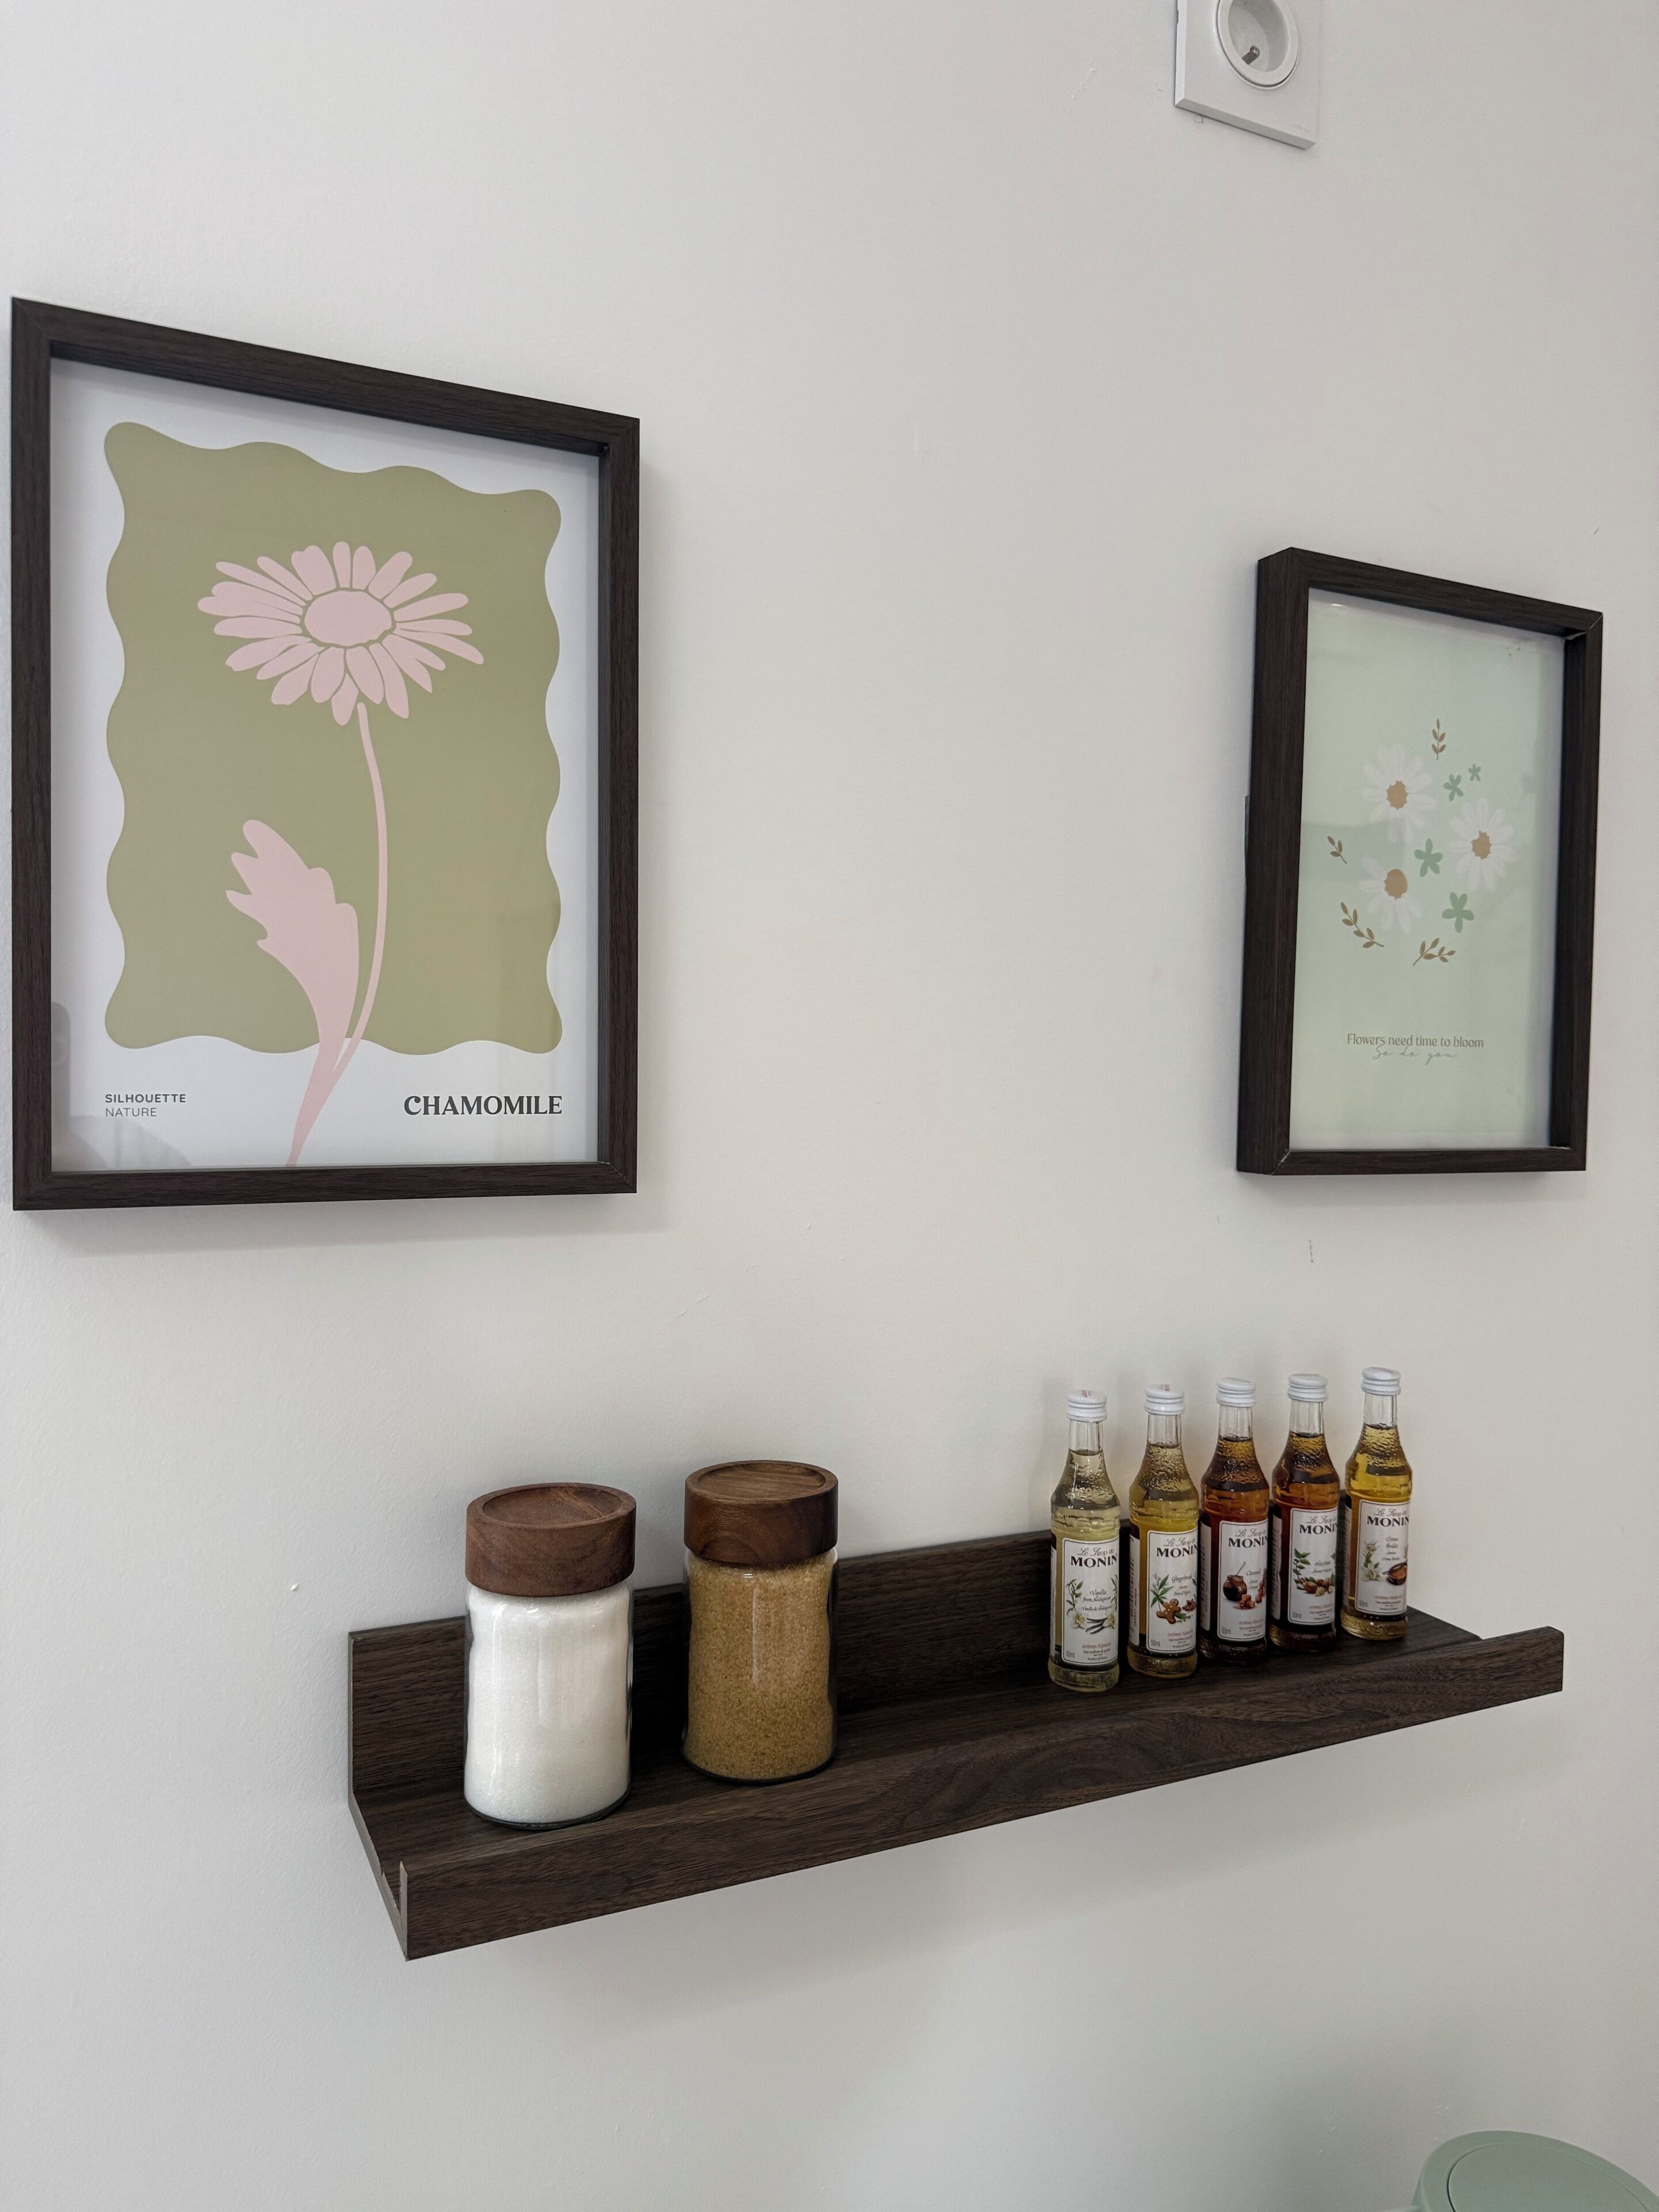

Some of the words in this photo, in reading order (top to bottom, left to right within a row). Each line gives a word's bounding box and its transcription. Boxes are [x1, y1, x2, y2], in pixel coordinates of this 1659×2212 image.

[1347, 1033, 1385, 1045] Flowers
[1388, 1035, 1412, 1046] need
[1416, 1036, 1437, 1047] time
[1440, 1037, 1450, 1047] to
[1453, 1036, 1483, 1047] bloom
[1372, 1045, 1394, 1060] So
[1400, 1046, 1419, 1056] do
[1425, 1052, 1457, 1066] you
[105, 1094, 186, 1103] SILHOUETTE
[404, 1096, 562, 1115] CHAMOMILE
[106, 1108, 157, 1117] NATURE
[1366, 1515, 1409, 1527] MONIN
[1078, 1547, 1089, 1555] Le
[1071, 1555, 1117, 1567] MONIN
